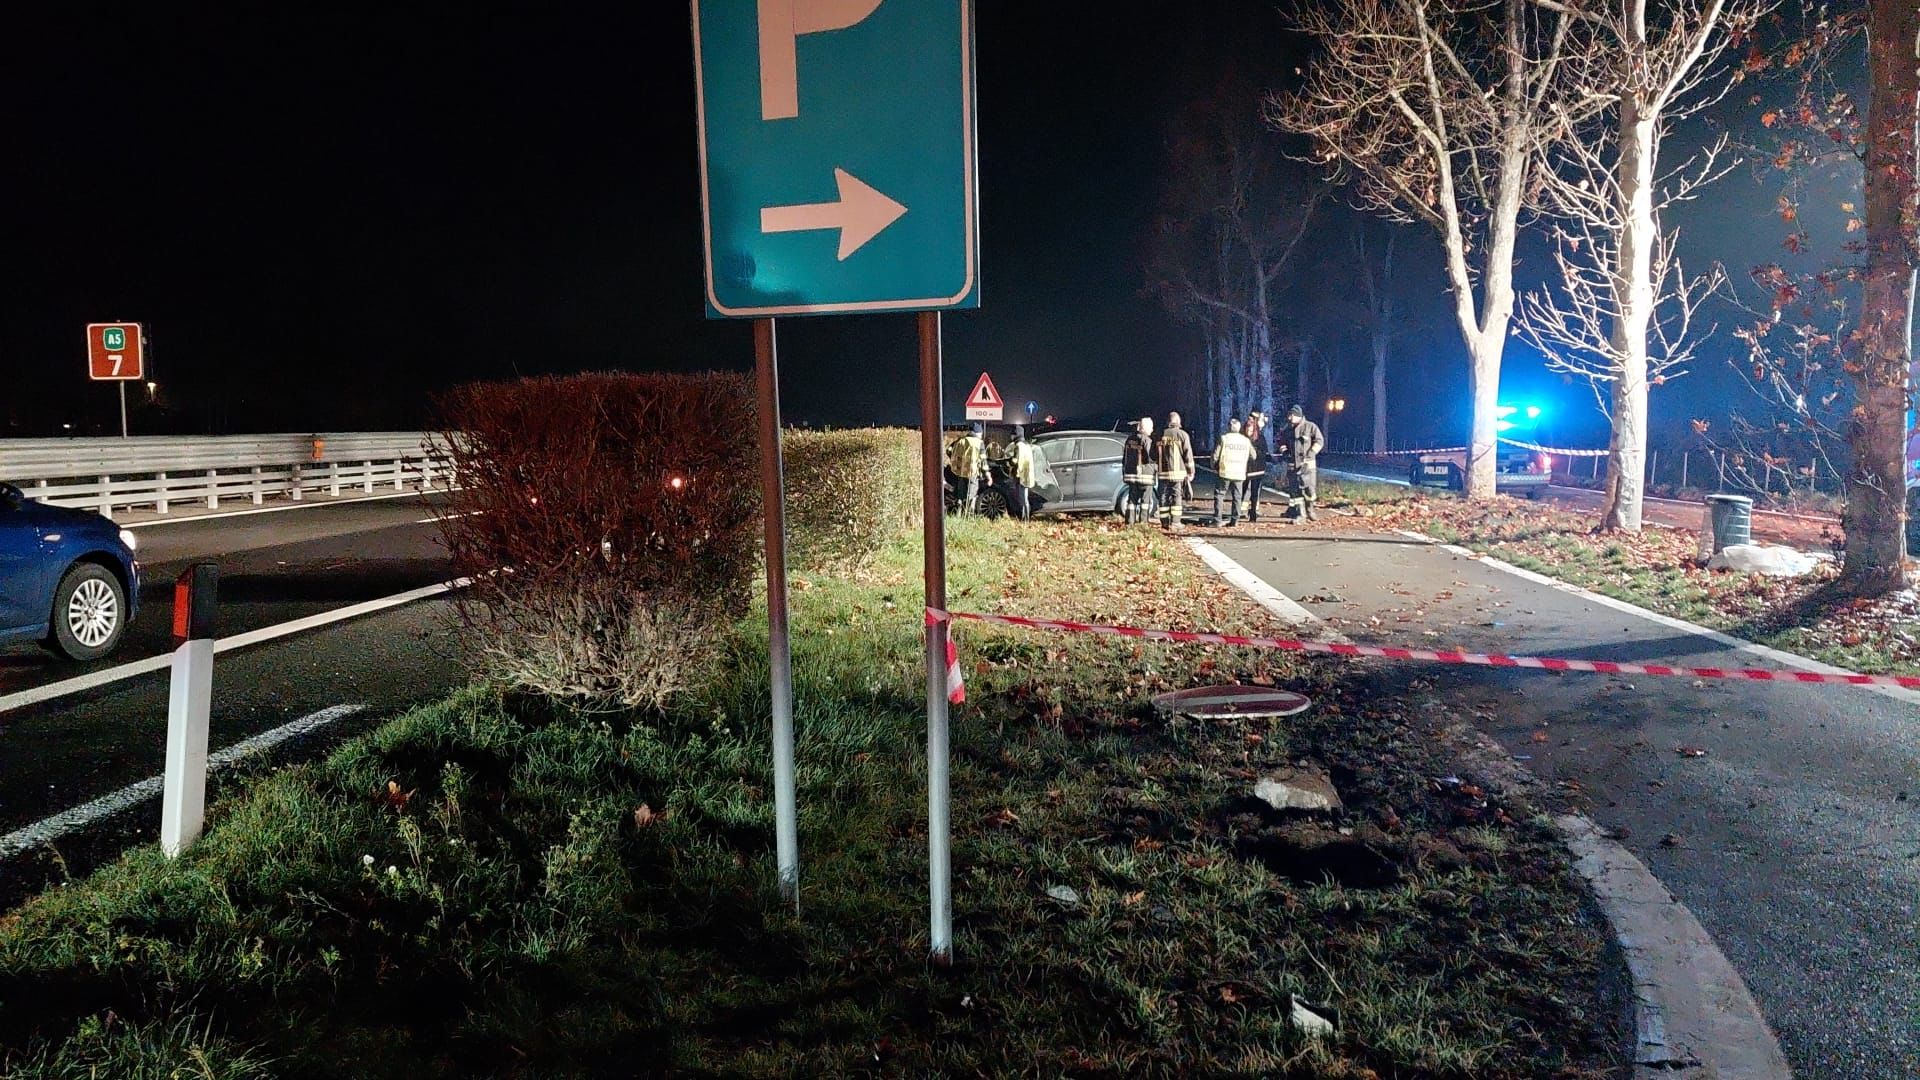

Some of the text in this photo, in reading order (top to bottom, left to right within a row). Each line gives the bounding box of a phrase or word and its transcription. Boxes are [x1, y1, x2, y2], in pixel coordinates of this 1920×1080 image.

[108, 333, 122, 345] A5
[107, 354, 123, 376] 7
[1424, 466, 1449, 475] POLIZIA
